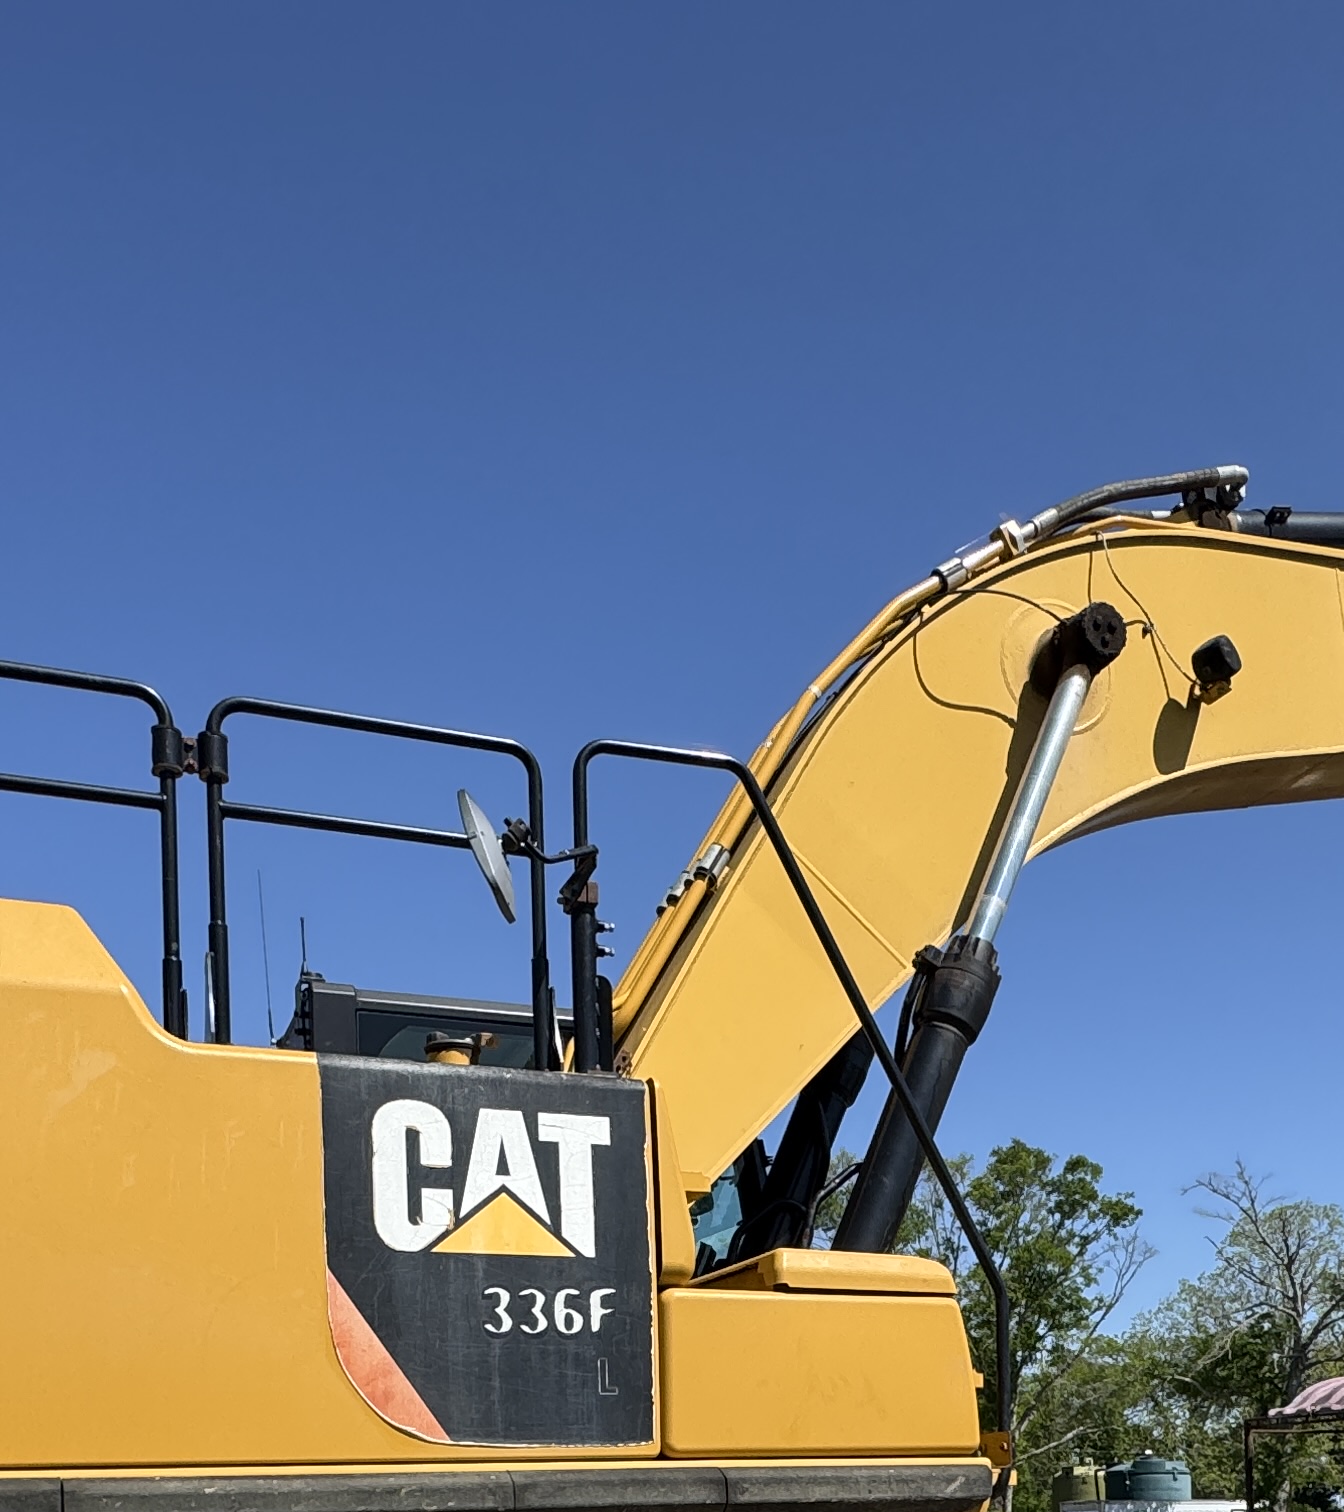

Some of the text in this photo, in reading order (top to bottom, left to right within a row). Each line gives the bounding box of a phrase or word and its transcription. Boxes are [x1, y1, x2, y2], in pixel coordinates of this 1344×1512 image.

[371, 1099, 611, 1258] CAT
[482, 1287, 617, 1335] 336F
[597, 1357, 619, 1395] L
